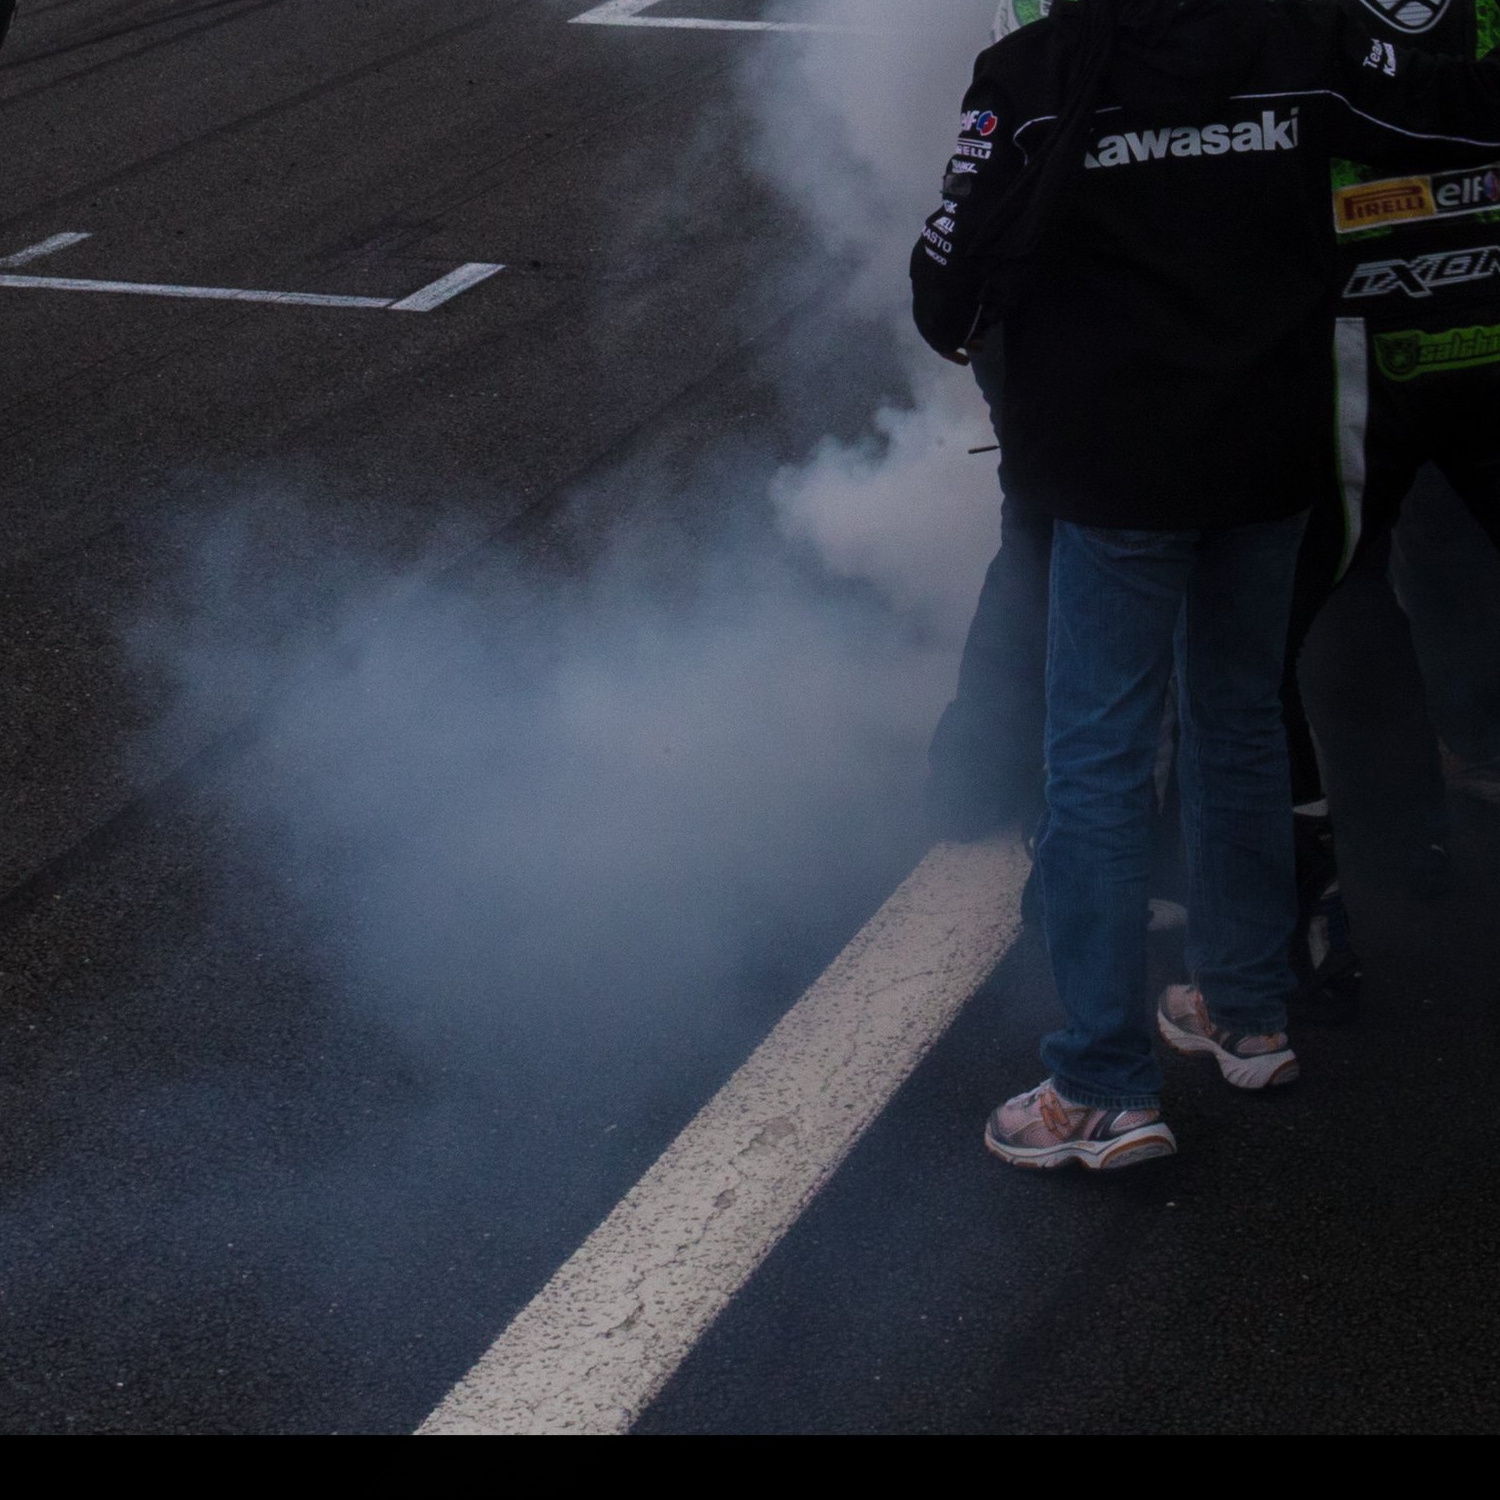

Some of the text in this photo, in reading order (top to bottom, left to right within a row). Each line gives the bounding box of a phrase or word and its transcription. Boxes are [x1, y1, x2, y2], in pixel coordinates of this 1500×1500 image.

[1084, 106, 1300, 170] awasaki
[1344, 174, 1484, 221] PIRELLI elf
